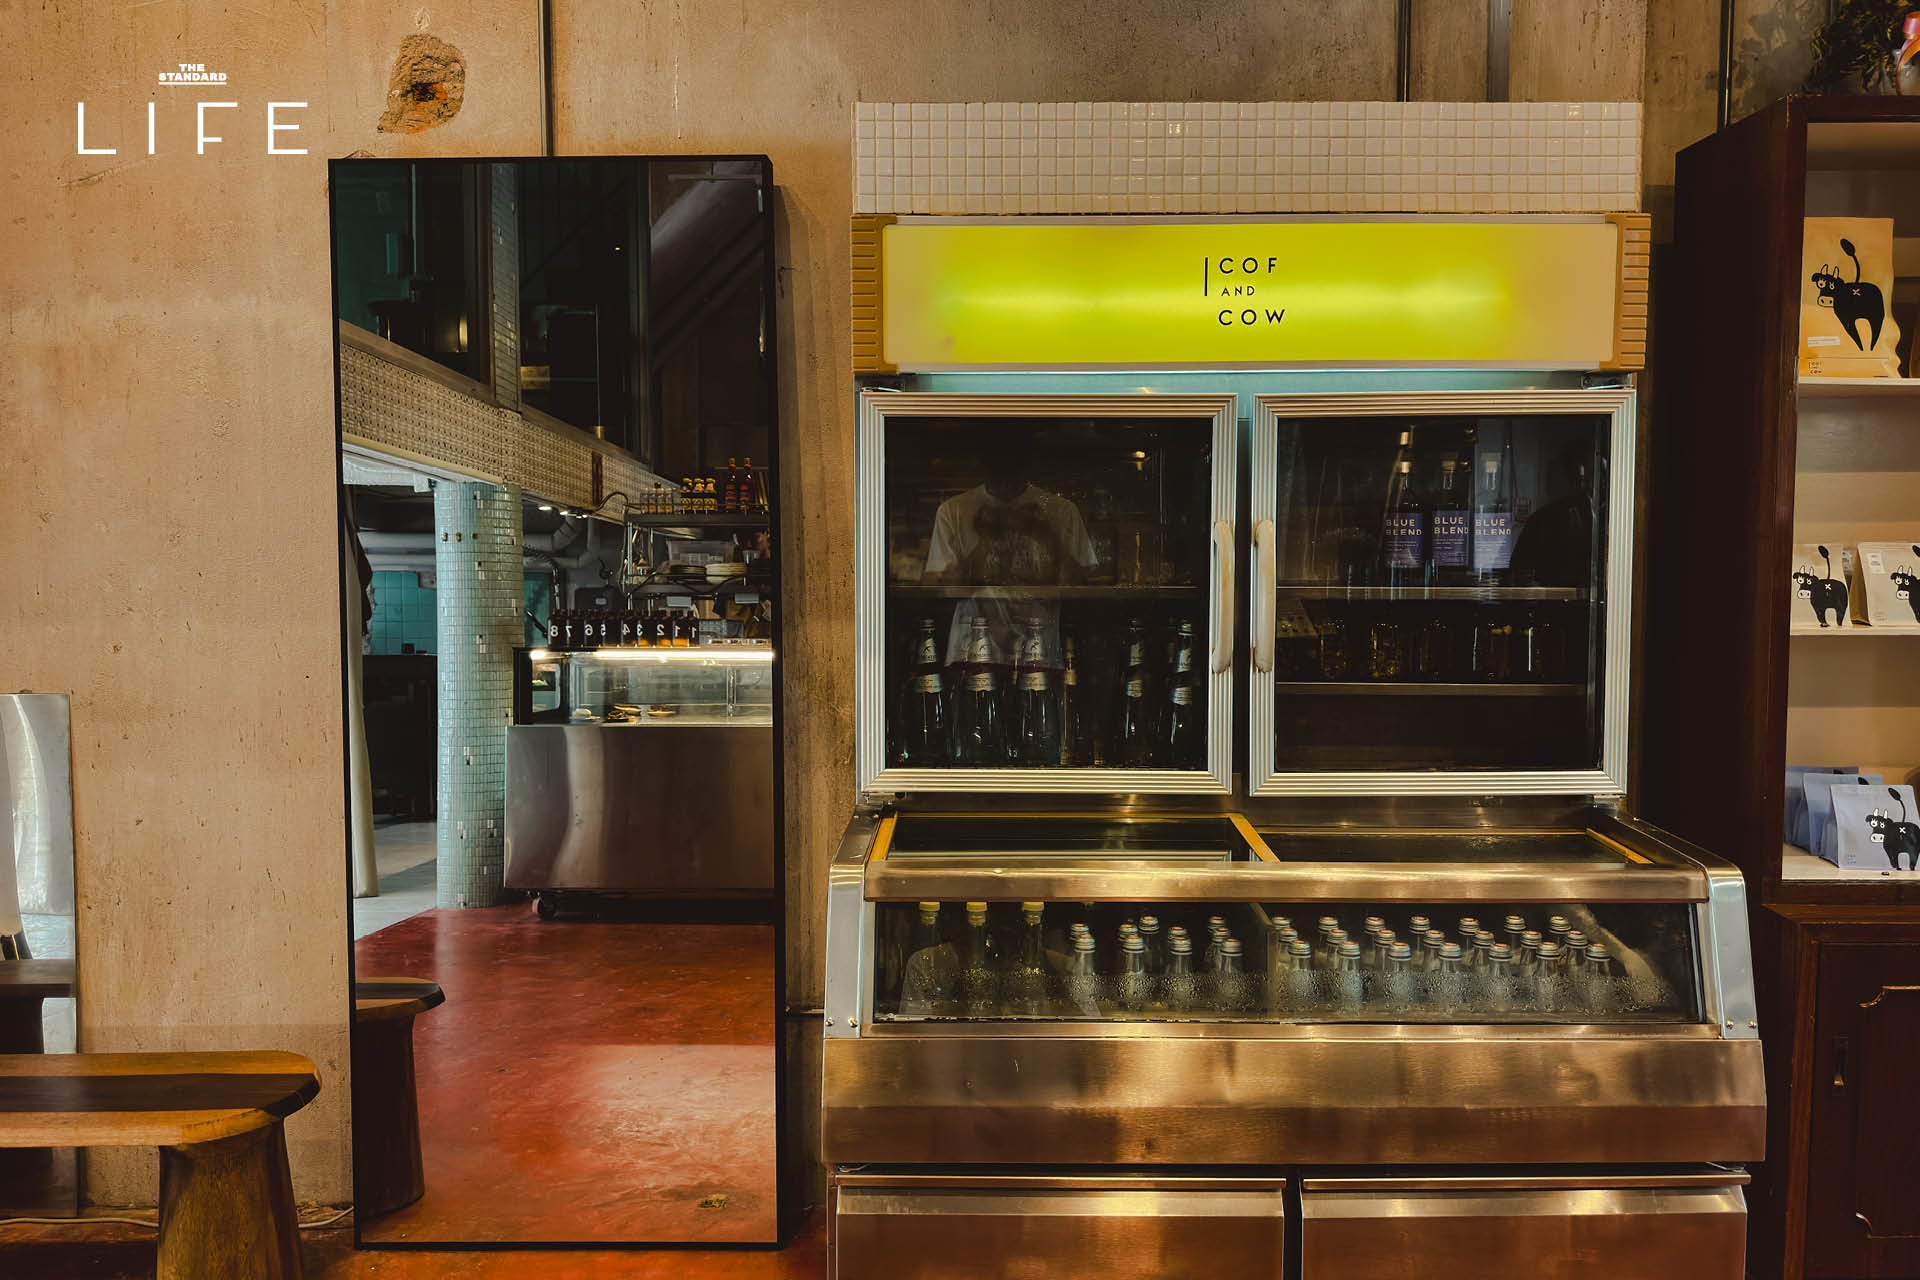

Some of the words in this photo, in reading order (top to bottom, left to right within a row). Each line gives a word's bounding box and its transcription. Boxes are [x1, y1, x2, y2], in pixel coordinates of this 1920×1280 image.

[1219, 257, 1278, 274] COF
[1221, 286, 1255, 296] AND
[1218, 309, 1286, 326] COW
[1385, 518, 1416, 527] BLUE
[1434, 516, 1465, 525] BLUE
[1475, 518, 1506, 527] BLUE
[1385, 528, 1423, 536] BLEND
[1433, 526, 1470, 535] BLEND
[1475, 528, 1512, 536] BLEND
